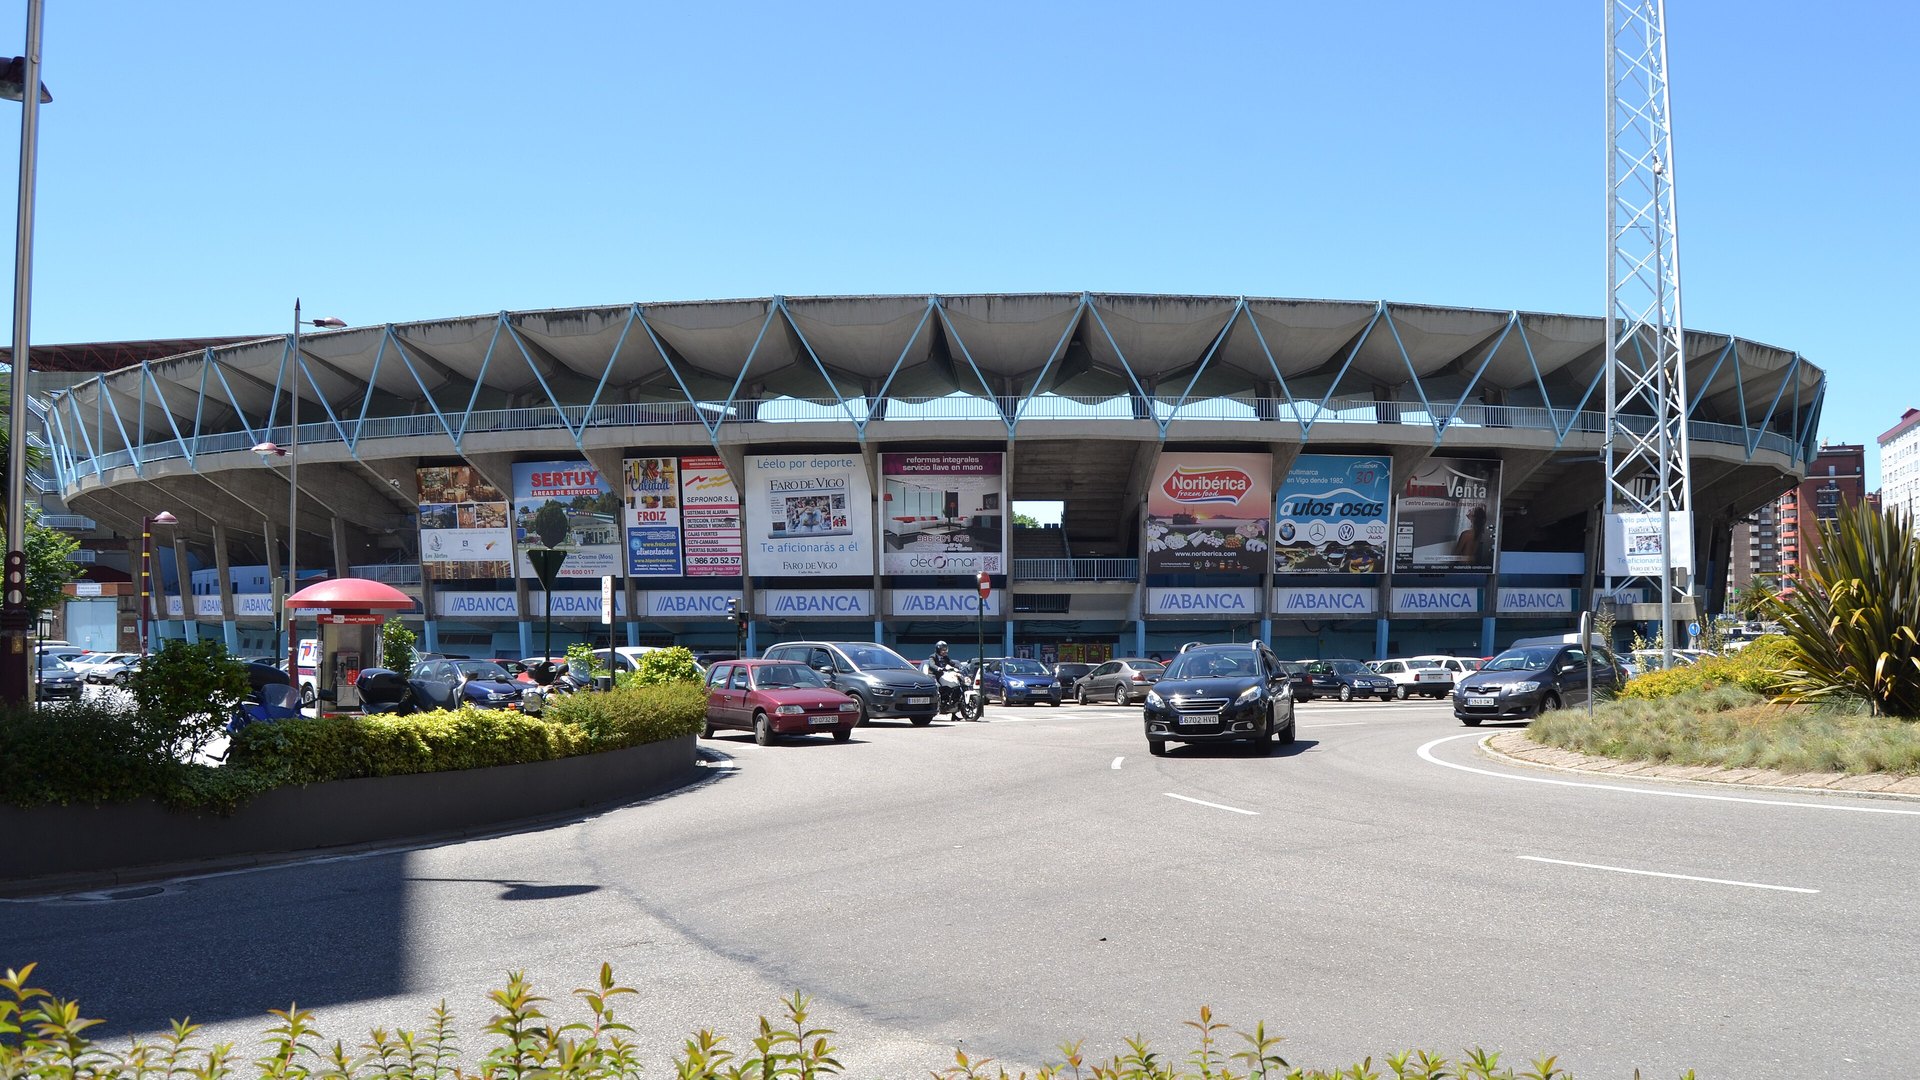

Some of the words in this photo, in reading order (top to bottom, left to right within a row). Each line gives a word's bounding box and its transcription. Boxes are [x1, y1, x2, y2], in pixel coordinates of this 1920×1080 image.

[757, 458, 786, 469] Léelo
[789, 460, 807, 470] por
[810, 458, 856, 469] deporte.
[942, 456, 979, 464] integrales
[531, 471, 598, 487] SERTUY
[631, 477, 670, 491] Calidad
[769, 479, 799, 490] FARO
[800, 480, 815, 489] DE
[816, 478, 844, 488] VIGO
[1172, 476, 1246, 490] Noribérica
[1296, 477, 1310, 485] Vigo
[1445, 475, 1487, 498] Venta
[1176, 490, 1202, 498] frozen
[1201, 489, 1219, 498] food
[1280, 499, 1384, 516] autosrosas
[637, 511, 667, 522] FROIZ
[761, 543, 774, 552] Te
[777, 541, 835, 553] aficionarás
[848, 541, 858, 552] él
[783, 561, 804, 570] FARO
[817, 561, 838, 570] VIGO
[910, 554, 977, 569] decomar
